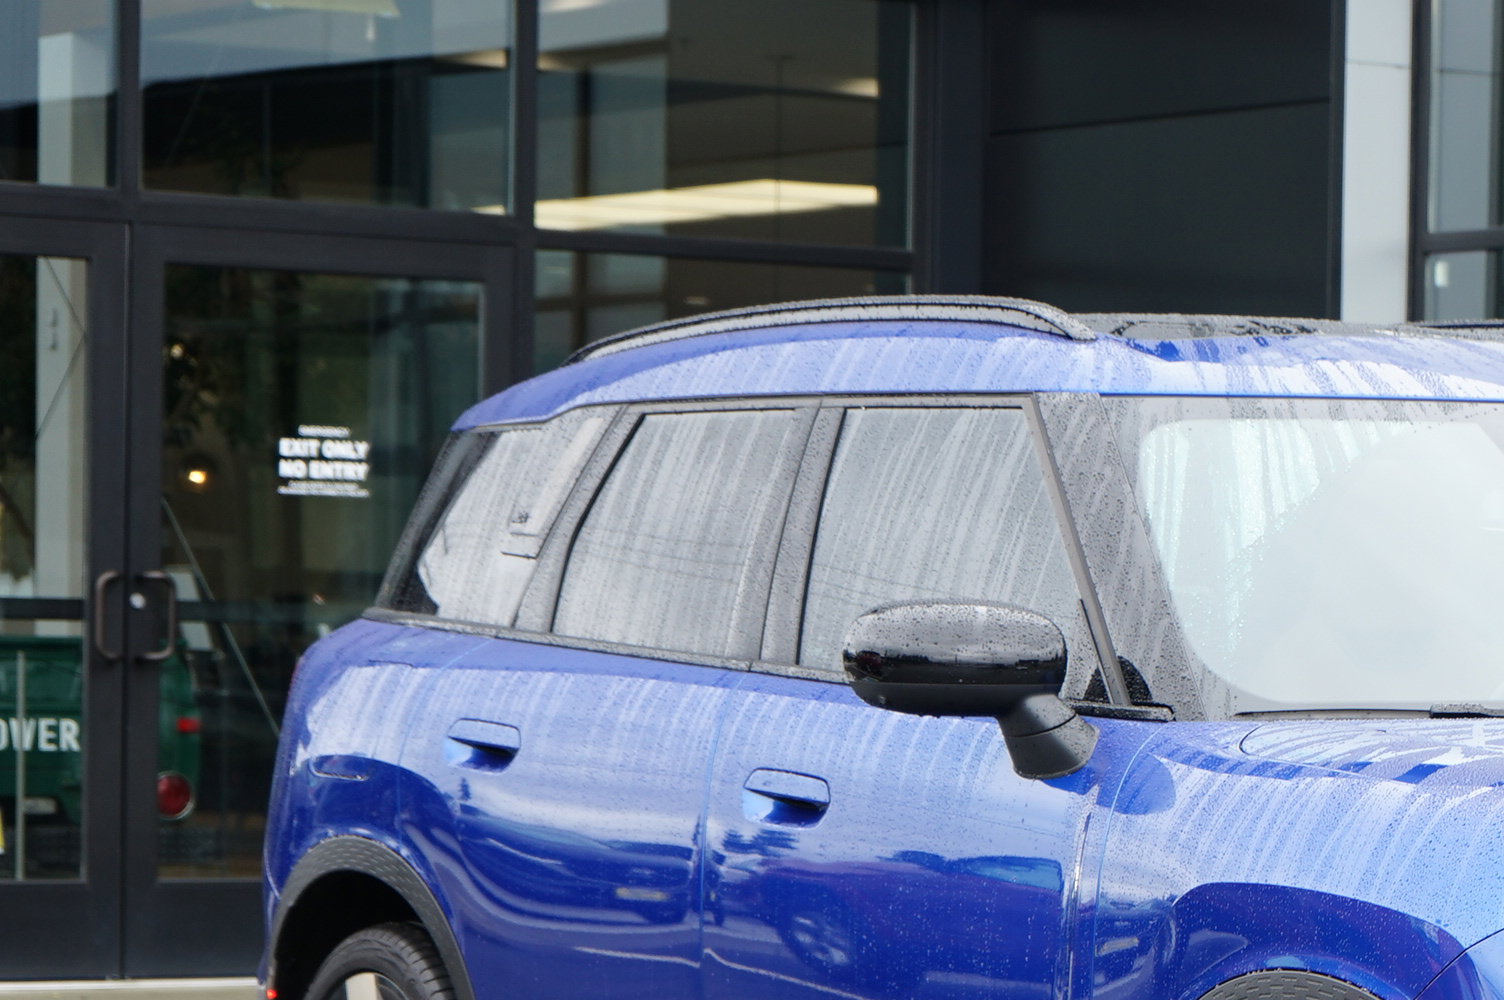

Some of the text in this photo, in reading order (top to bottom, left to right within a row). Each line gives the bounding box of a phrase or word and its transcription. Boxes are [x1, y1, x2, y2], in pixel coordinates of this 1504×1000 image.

[279, 437, 369, 460] EXIT ONLY
[279, 459, 369, 481] NO ENTRY
